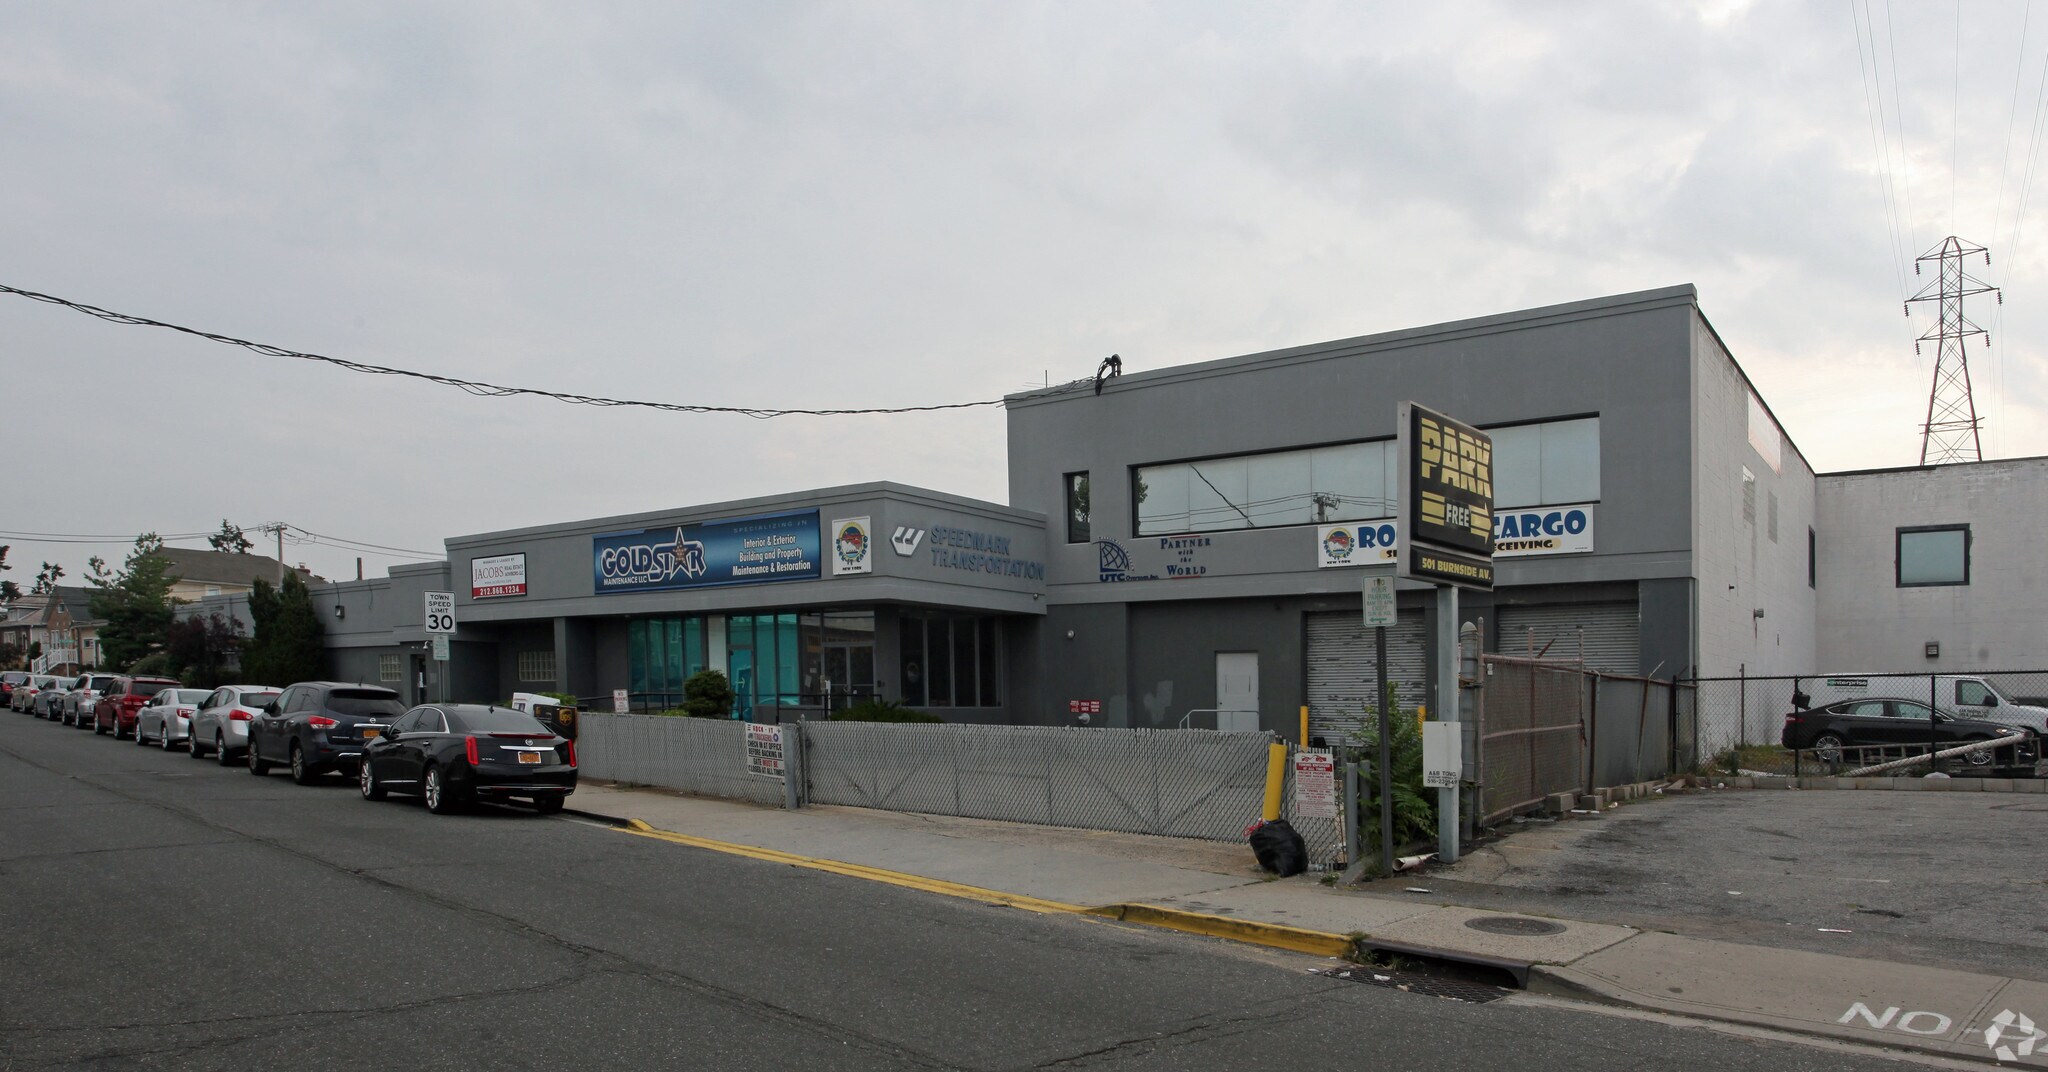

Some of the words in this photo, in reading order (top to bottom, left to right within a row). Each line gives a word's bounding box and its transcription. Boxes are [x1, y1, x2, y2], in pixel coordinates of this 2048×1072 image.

[1422, 418, 1492, 499] PARK
[1446, 503, 1471, 528] FREE
[733, 521, 793, 534] SPECIALIZING
[744, 538, 766, 548] Interior
[767, 536, 772, 545] &
[773, 534, 796, 545] Exterior
[930, 524, 1012, 556] SPEEDMARK
[740, 552, 764, 562] Building
[765, 549, 775, 559] and
[777, 547, 802, 560] Property
[733, 565, 769, 576] Maintenance
[770, 562, 775, 573] &
[777, 560, 810, 572] Restoration
[931, 547, 1045, 580] TRANSPORTATION
[1422, 557, 1435, 569] 501
[1437, 560, 1477, 577] BURNSIDE
[1479, 569, 1490, 579] AV.
[474, 566, 504, 582] JACOBS
[604, 576, 637, 585] MAINTENANCE
[1100, 573, 1125, 582] UTC
[428, 614, 453, 630] 30
[748, 740, 758, 748] CHECK
[769, 743, 782, 751] OFFICE
[749, 748, 761, 756] BEFORE
[762, 750, 777, 758] BACKING
[1837, 1002, 1952, 1035] NO
